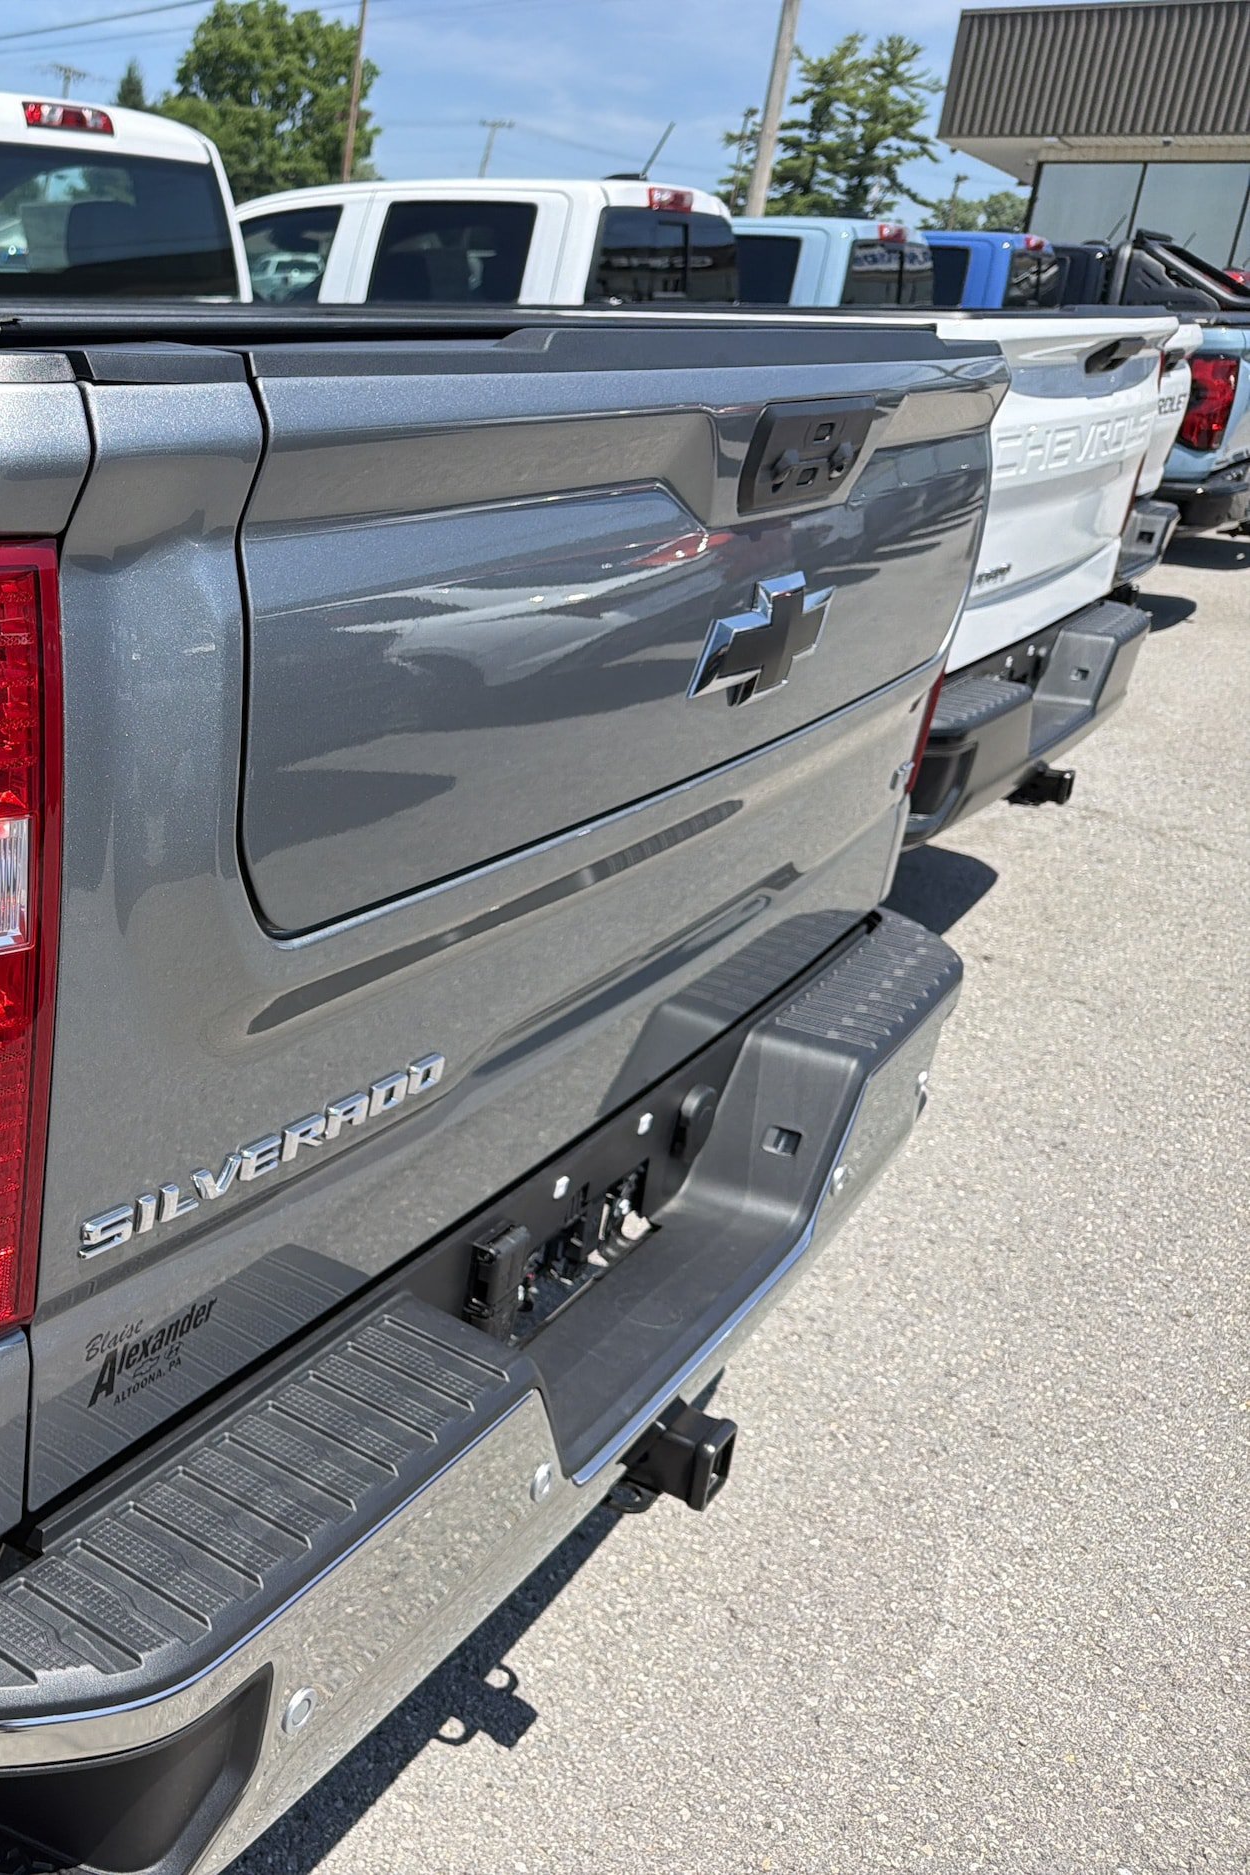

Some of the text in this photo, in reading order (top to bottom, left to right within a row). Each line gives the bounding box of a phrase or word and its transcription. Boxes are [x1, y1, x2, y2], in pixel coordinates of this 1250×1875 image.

[77, 1052, 445, 1260] SILVERADO
[85, 1319, 143, 1361] Blaise
[87, 1296, 217, 1408] Alexander
[113, 1357, 181, 1406] ALTOONA, PA
